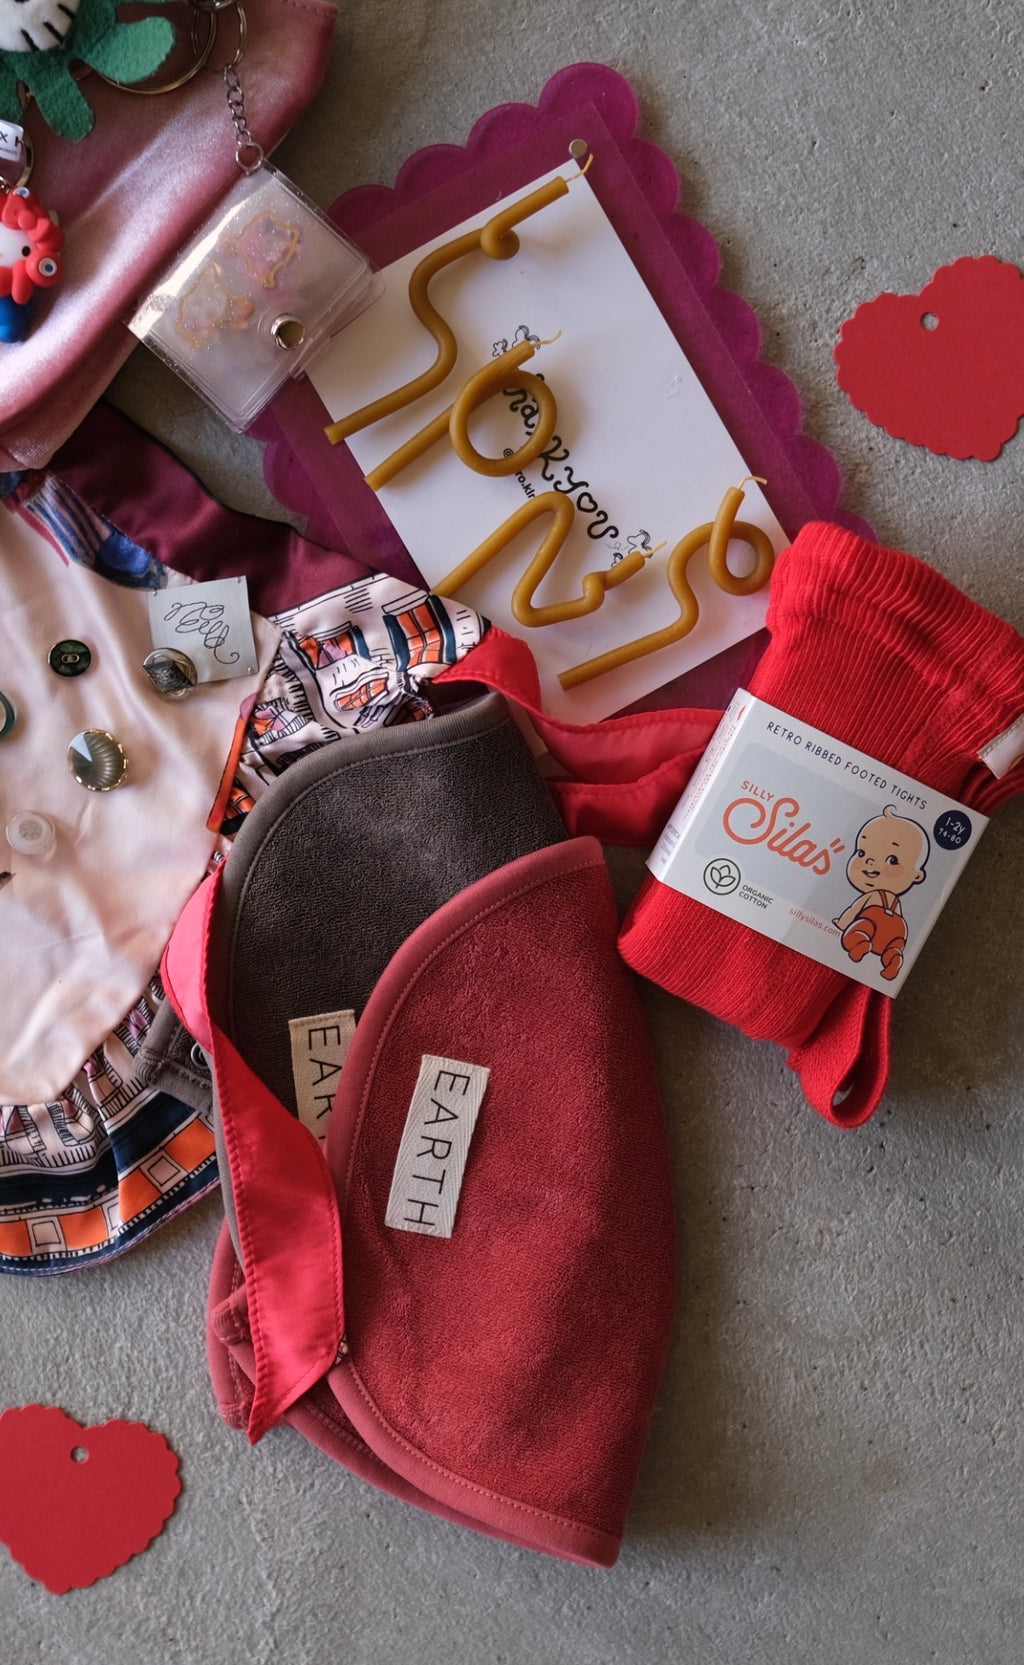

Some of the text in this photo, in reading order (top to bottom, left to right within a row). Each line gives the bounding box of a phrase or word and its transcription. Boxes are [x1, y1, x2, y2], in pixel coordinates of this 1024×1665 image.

[766, 721, 927, 810] RETRO RIBBED FOOTED TIGHTS
[741, 780, 774, 802] SILLY
[938, 827, 962, 844] 74-80
[738, 891, 768, 909] COTTON
[742, 884, 774, 904] ORGANIC
[789, 908, 841, 937] sillysilas.com
[404, 1070, 471, 1226] EARTH
